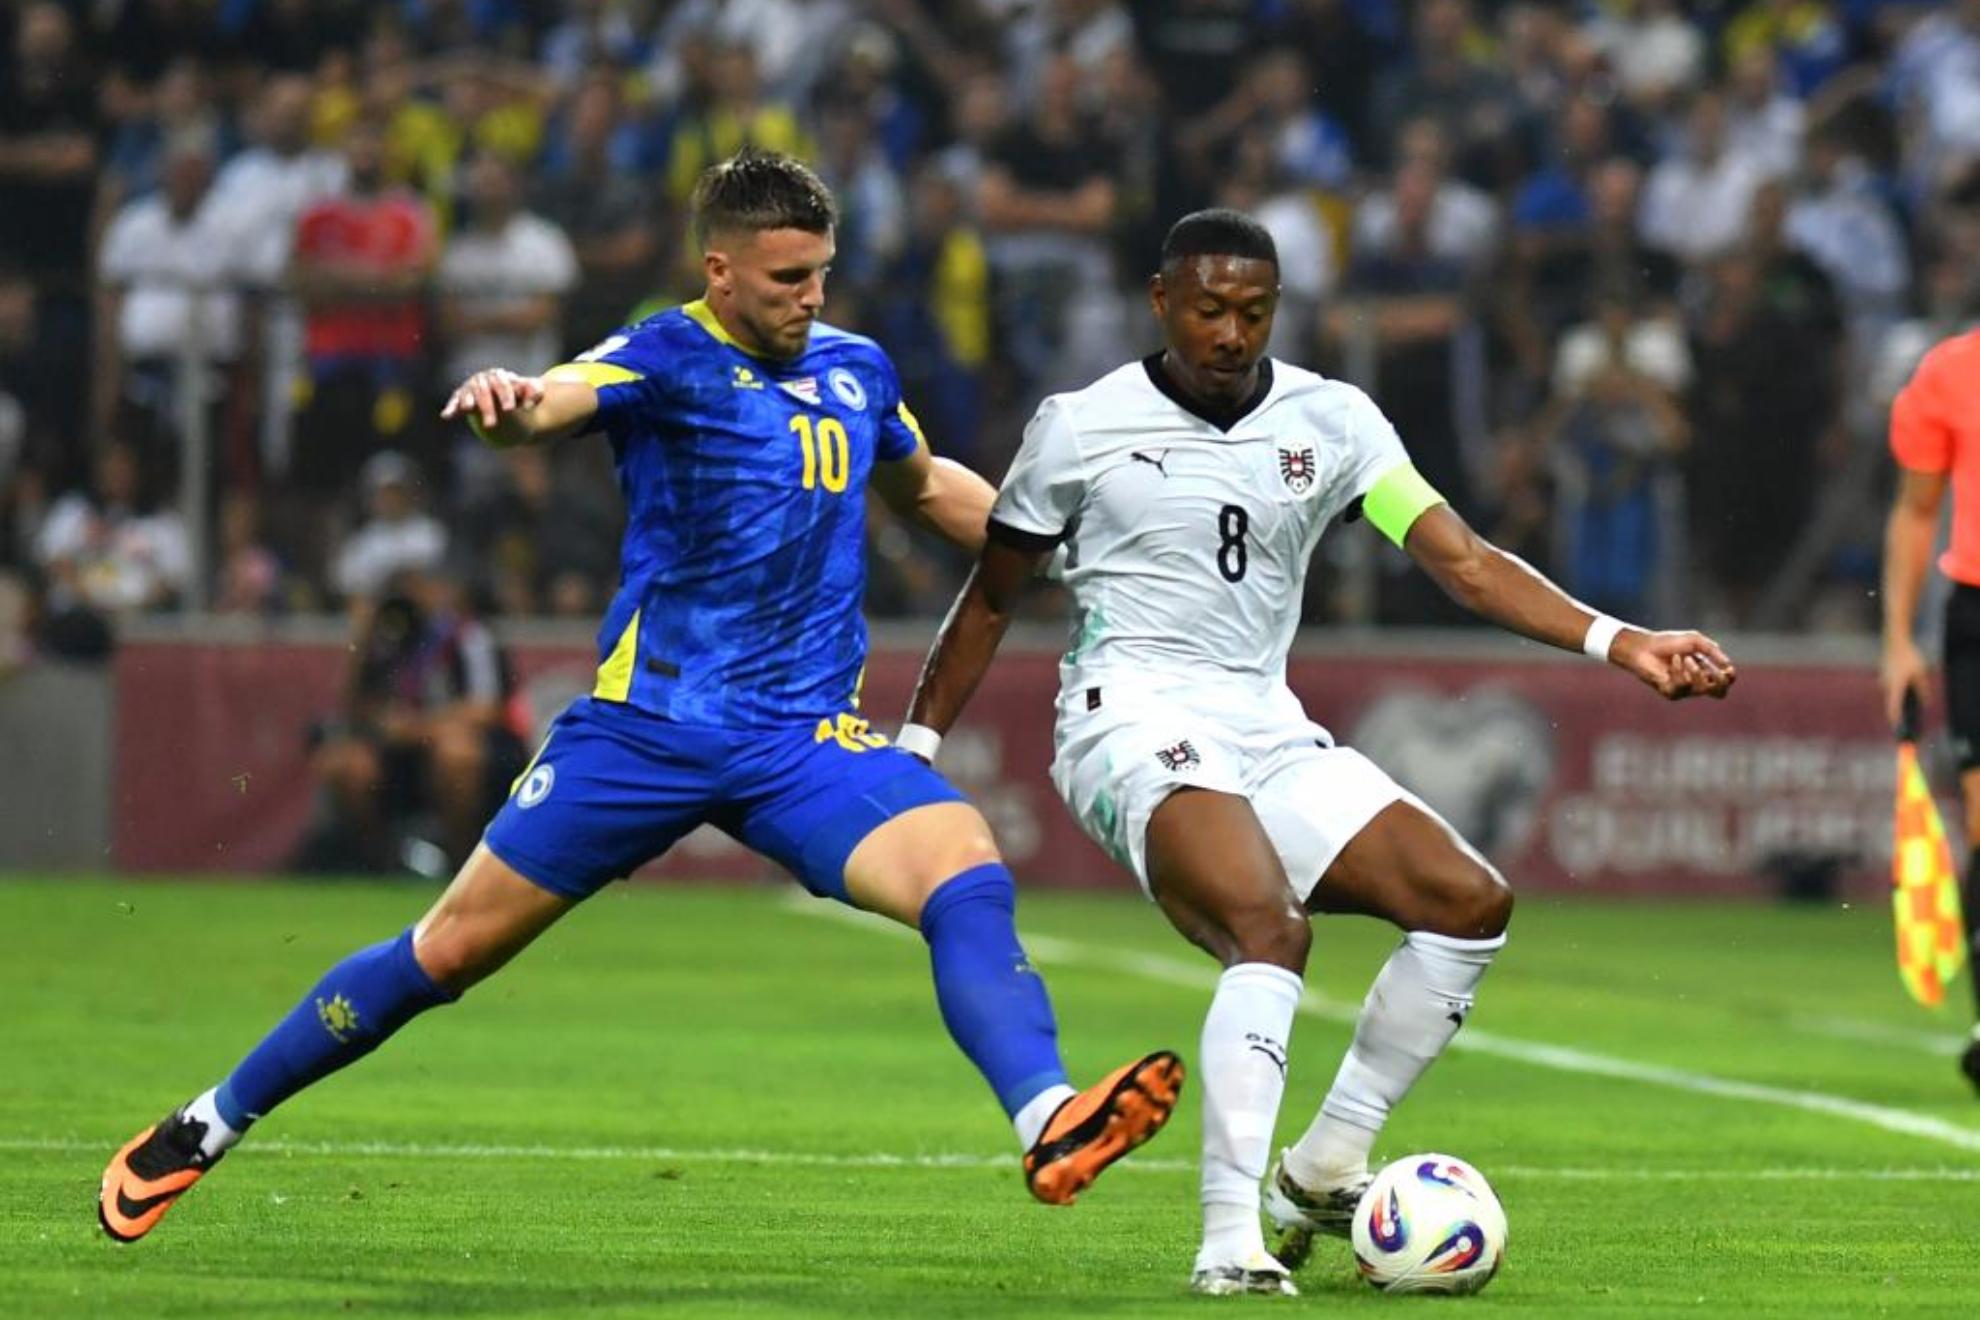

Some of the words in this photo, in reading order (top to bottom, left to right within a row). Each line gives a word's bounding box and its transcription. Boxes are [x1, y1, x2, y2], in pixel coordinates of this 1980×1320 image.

[789, 413, 848, 493] 10
[1217, 504, 1248, 583] 8
[1594, 737, 1900, 793] EUROPEA
